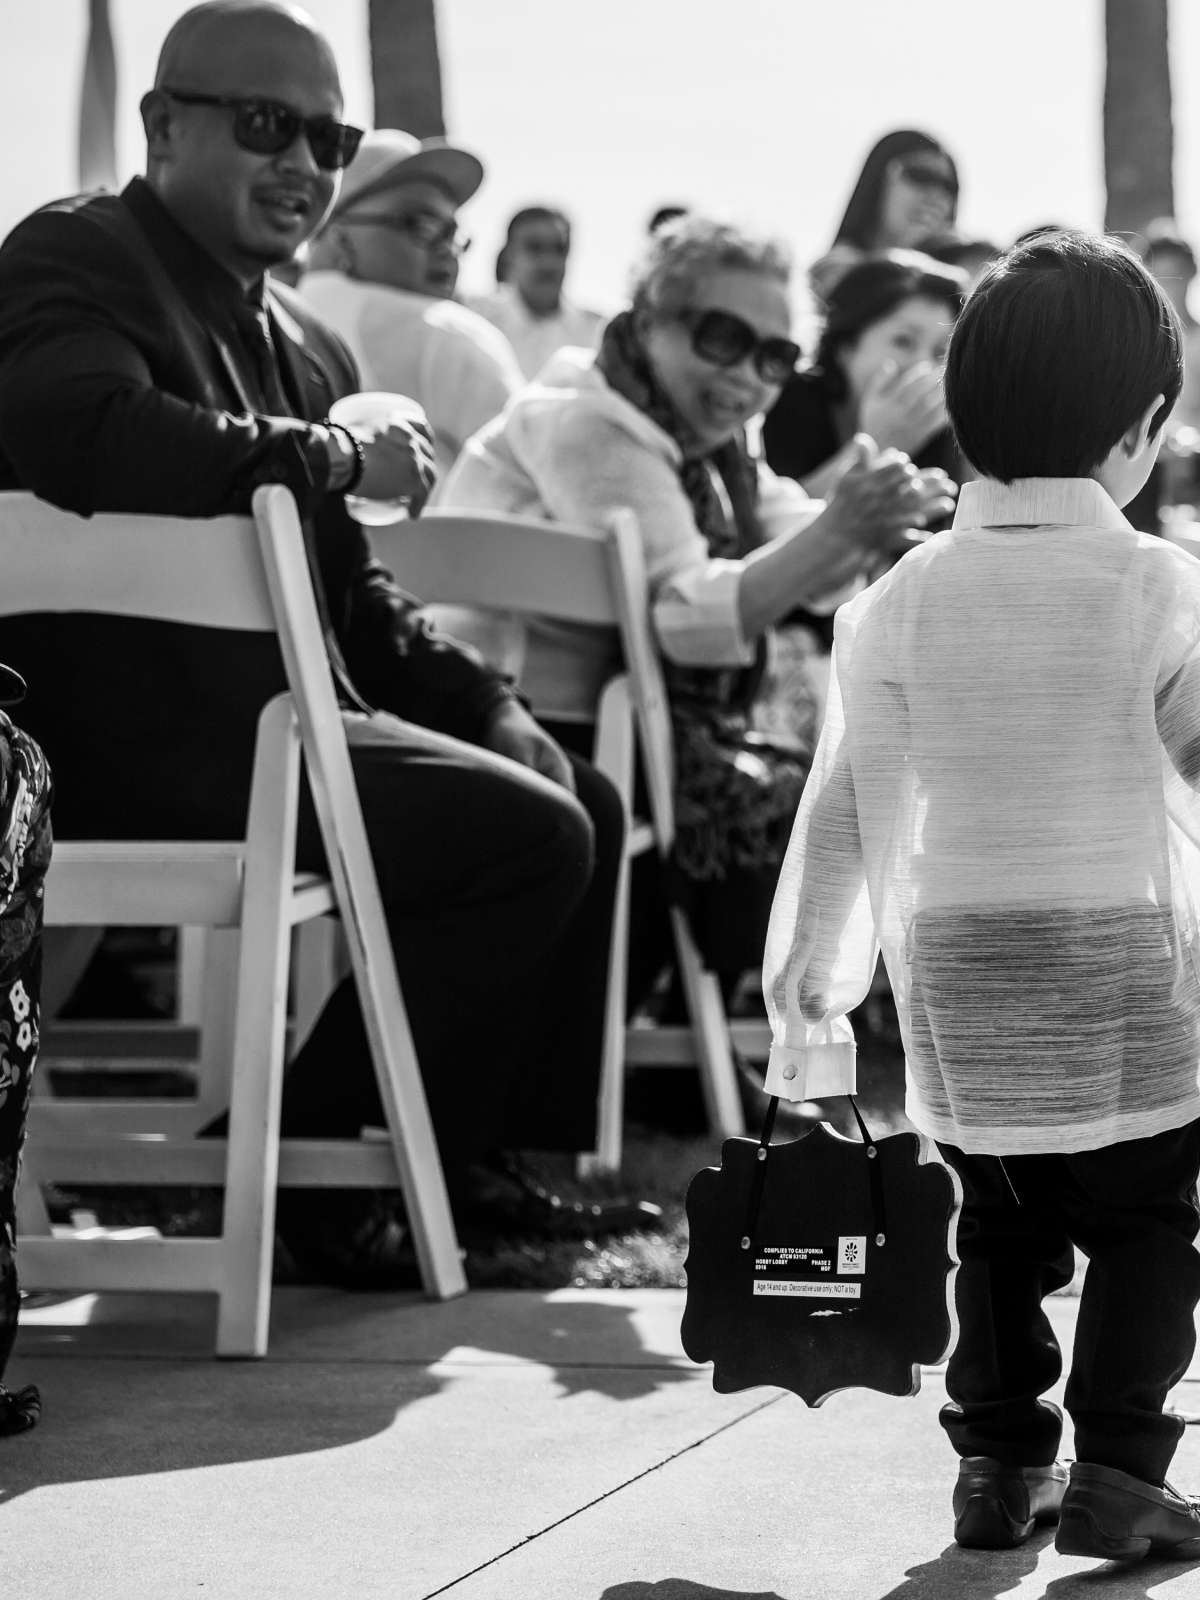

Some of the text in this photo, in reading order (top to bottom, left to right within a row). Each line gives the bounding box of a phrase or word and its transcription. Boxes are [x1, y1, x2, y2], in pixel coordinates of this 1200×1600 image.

[757, 1283, 766, 1292] Age
[789, 1284, 813, 1292] Decorative
[834, 1285, 845, 1293] NOT
